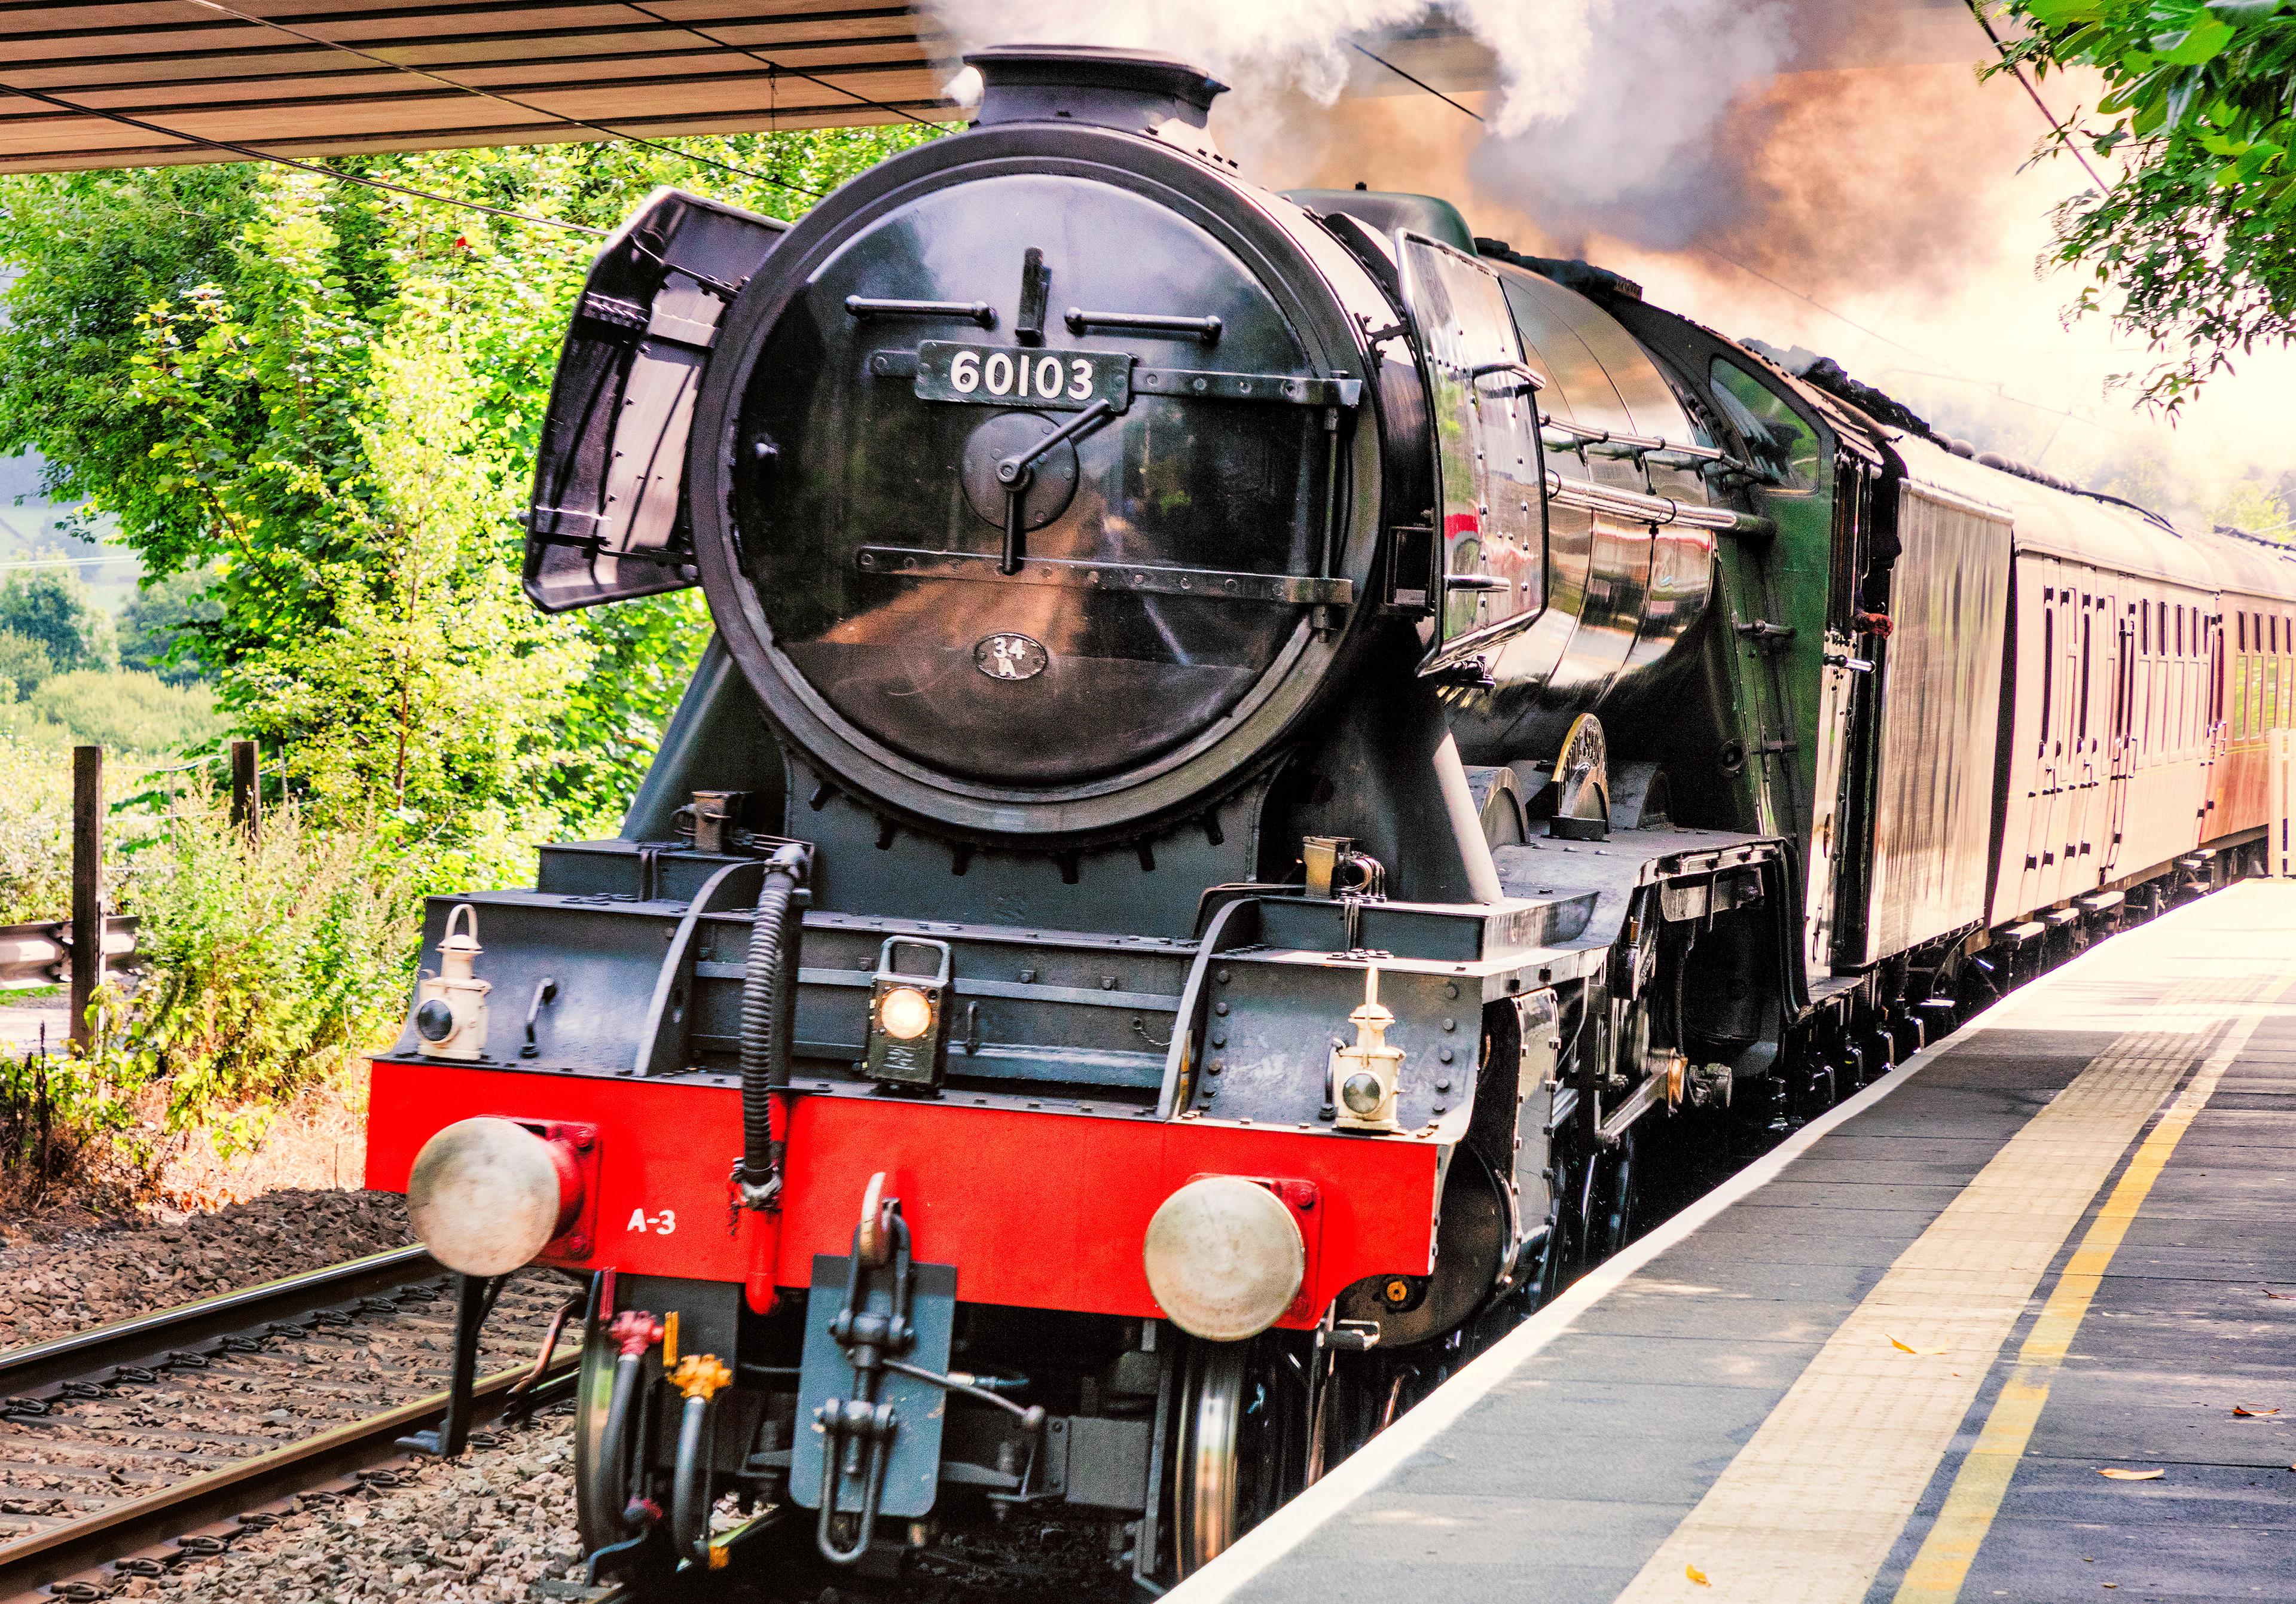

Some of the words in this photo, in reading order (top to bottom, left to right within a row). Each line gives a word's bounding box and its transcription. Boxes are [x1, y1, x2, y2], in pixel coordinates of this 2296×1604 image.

[950, 350, 1094, 401] 60103
[993, 637, 1026, 660] 34
[998, 658, 1016, 677] A
[627, 1208, 676, 1235] A-3
